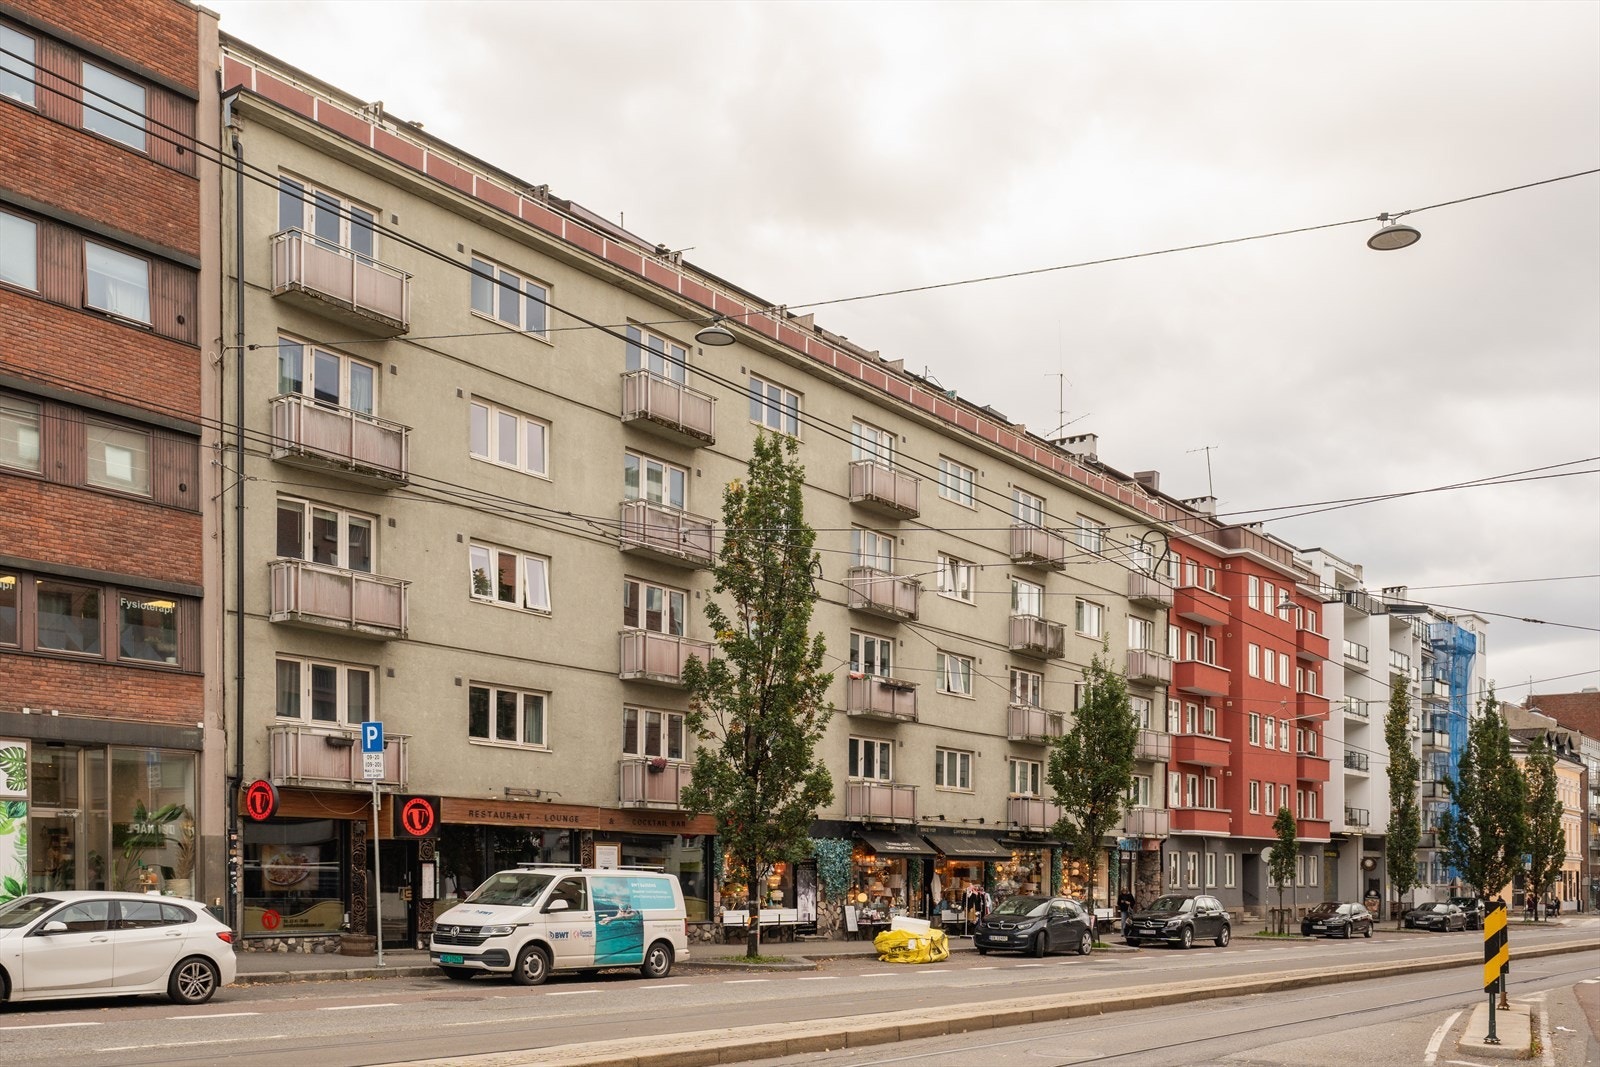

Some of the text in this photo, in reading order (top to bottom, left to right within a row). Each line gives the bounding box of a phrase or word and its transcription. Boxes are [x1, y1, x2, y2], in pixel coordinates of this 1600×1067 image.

[120, 597, 173, 614] Fysioterapi
[366, 726, 378, 749] P
[468, 810, 531, 820] RESTAURANT
[544, 814, 580, 823] LOUNGE
[632, 819, 668, 827] COCKTAIL
[554, 931, 569, 939] BWT
